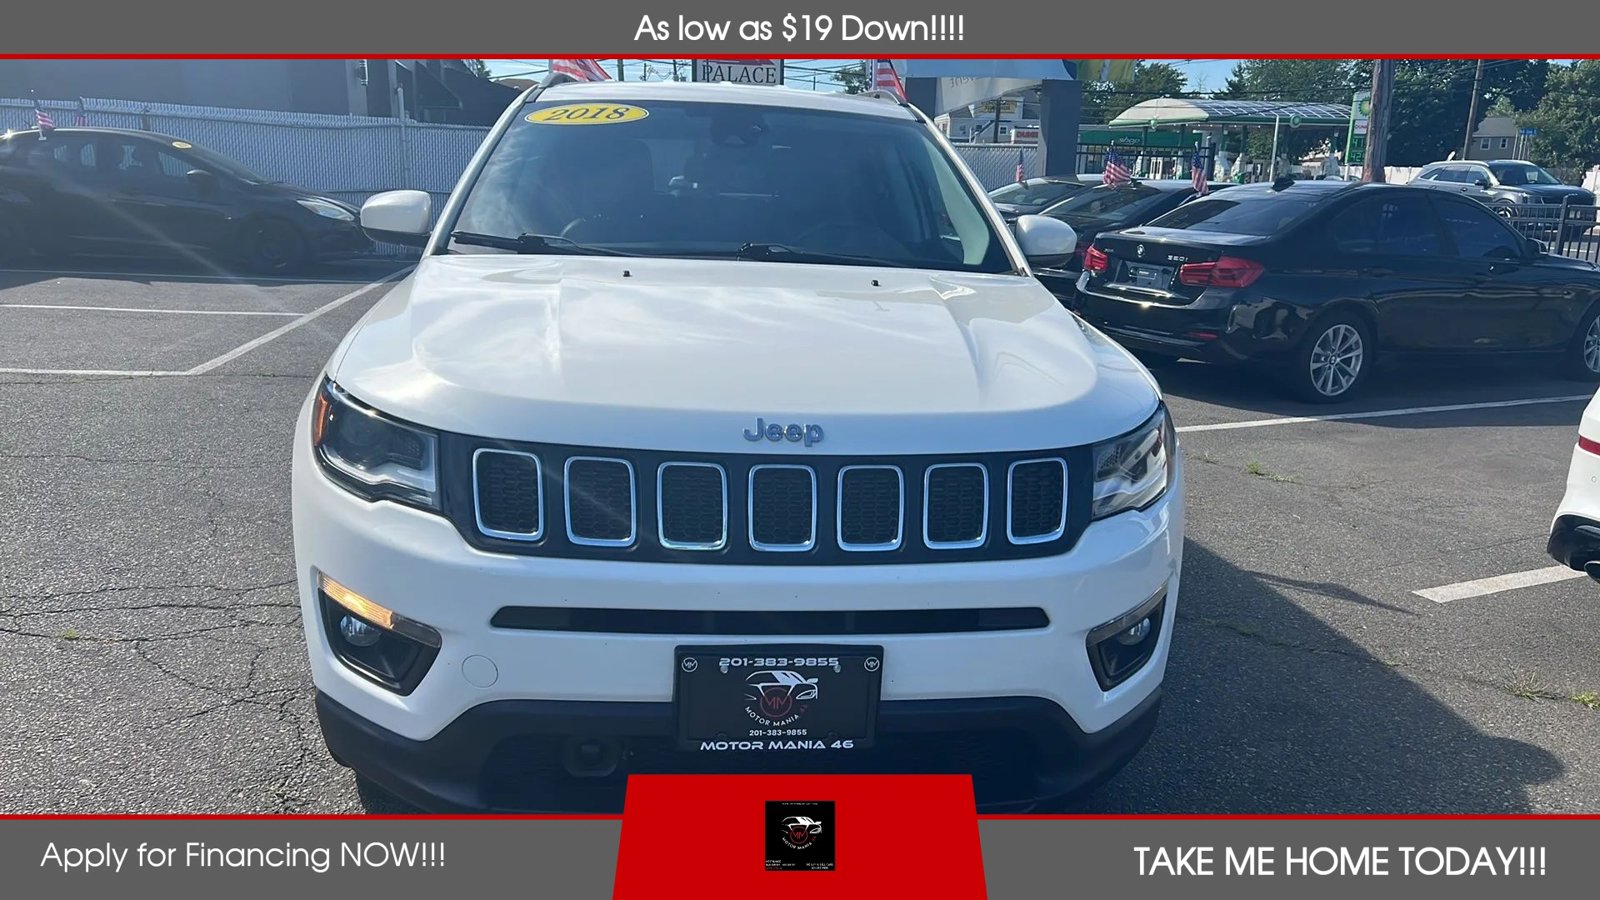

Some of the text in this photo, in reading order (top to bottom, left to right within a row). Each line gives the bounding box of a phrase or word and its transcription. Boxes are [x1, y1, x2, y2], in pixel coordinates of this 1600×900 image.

[702, 64, 777, 84] PALACE
[543, 106, 630, 121] 2018
[742, 416, 825, 448] Jeep
[718, 657, 840, 667] 201-383-9855
[744, 706, 800, 727] MOTOR MANIA
[749, 728, 808, 736] 201-383-9855
[700, 739, 854, 751] MOTOR MANIA 46
